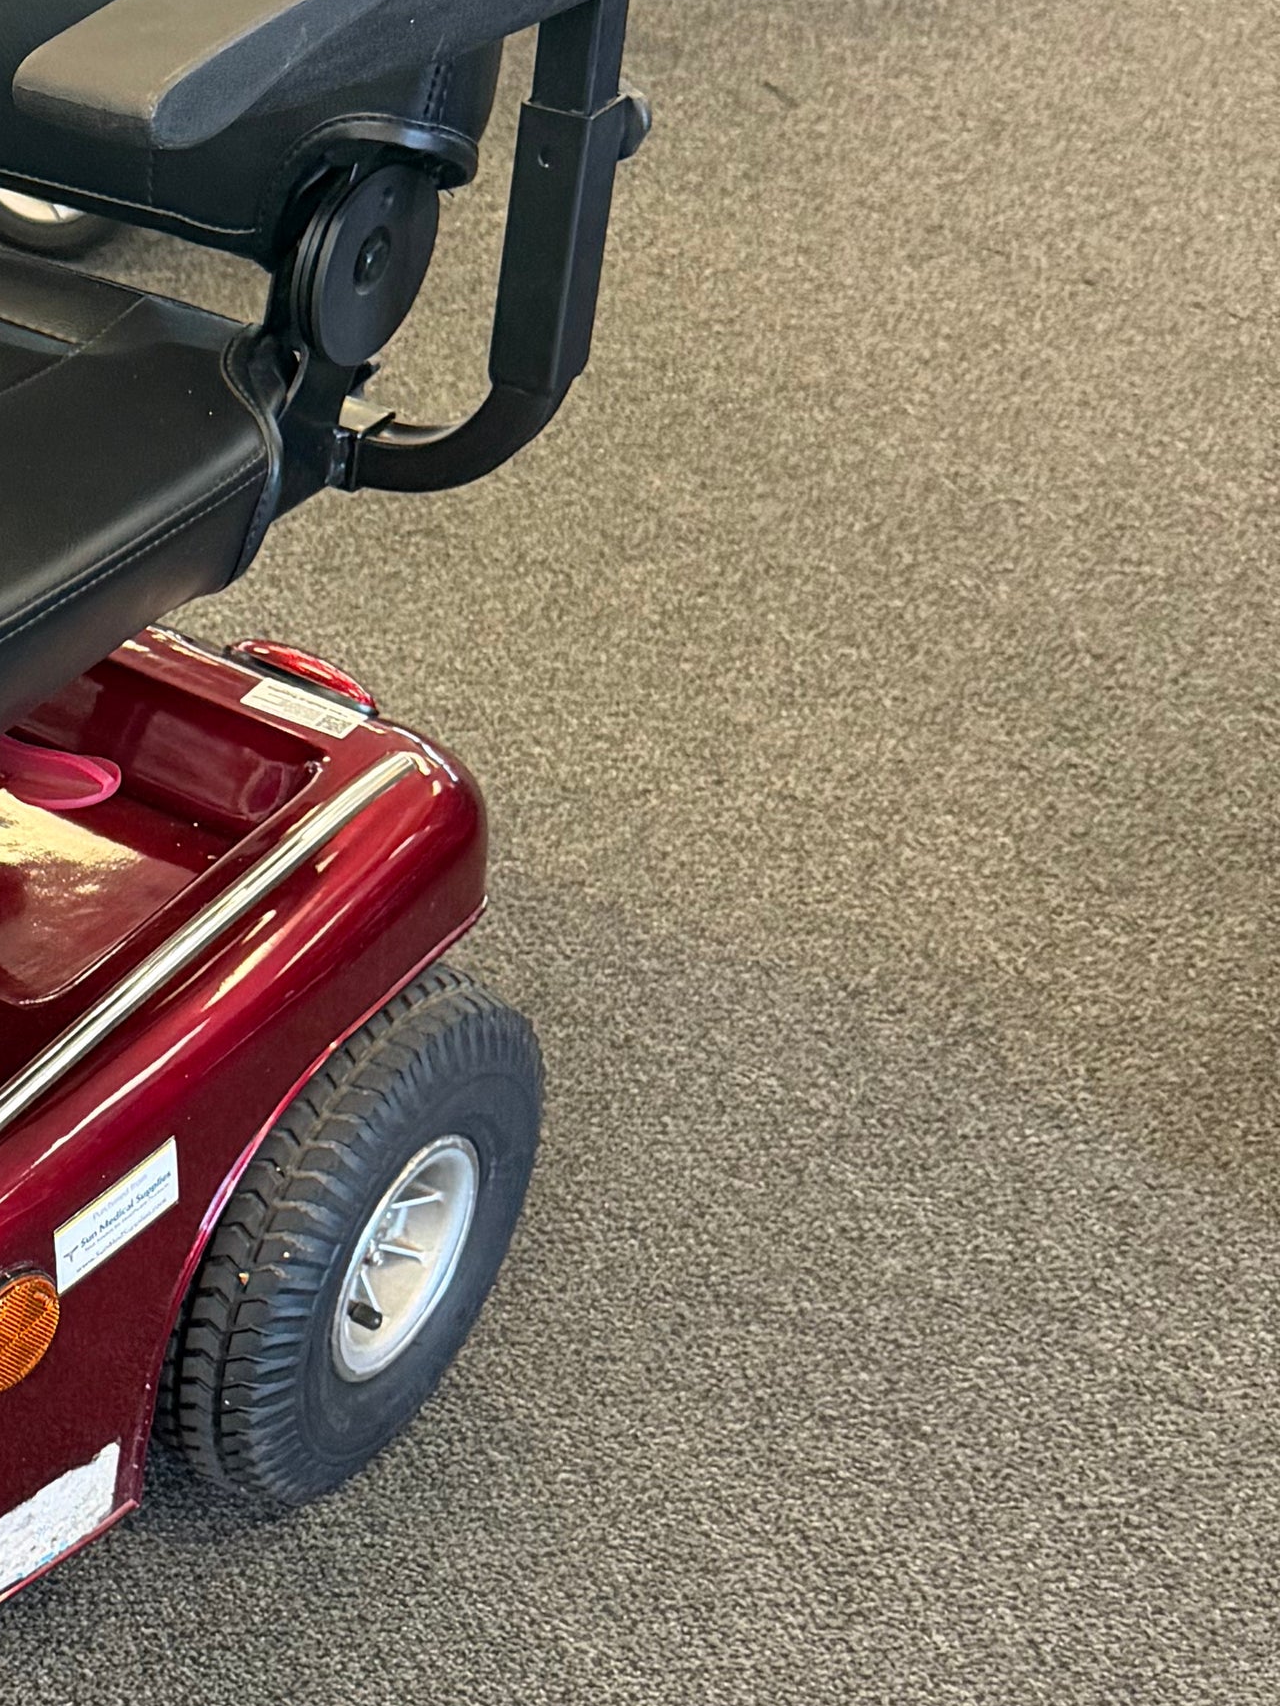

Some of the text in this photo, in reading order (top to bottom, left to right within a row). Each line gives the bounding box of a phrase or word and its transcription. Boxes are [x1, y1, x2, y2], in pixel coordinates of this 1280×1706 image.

[80, 1230, 98, 1248] Sun
[99, 1199, 134, 1233] Medical
[135, 1171, 172, 1204] Supplies
